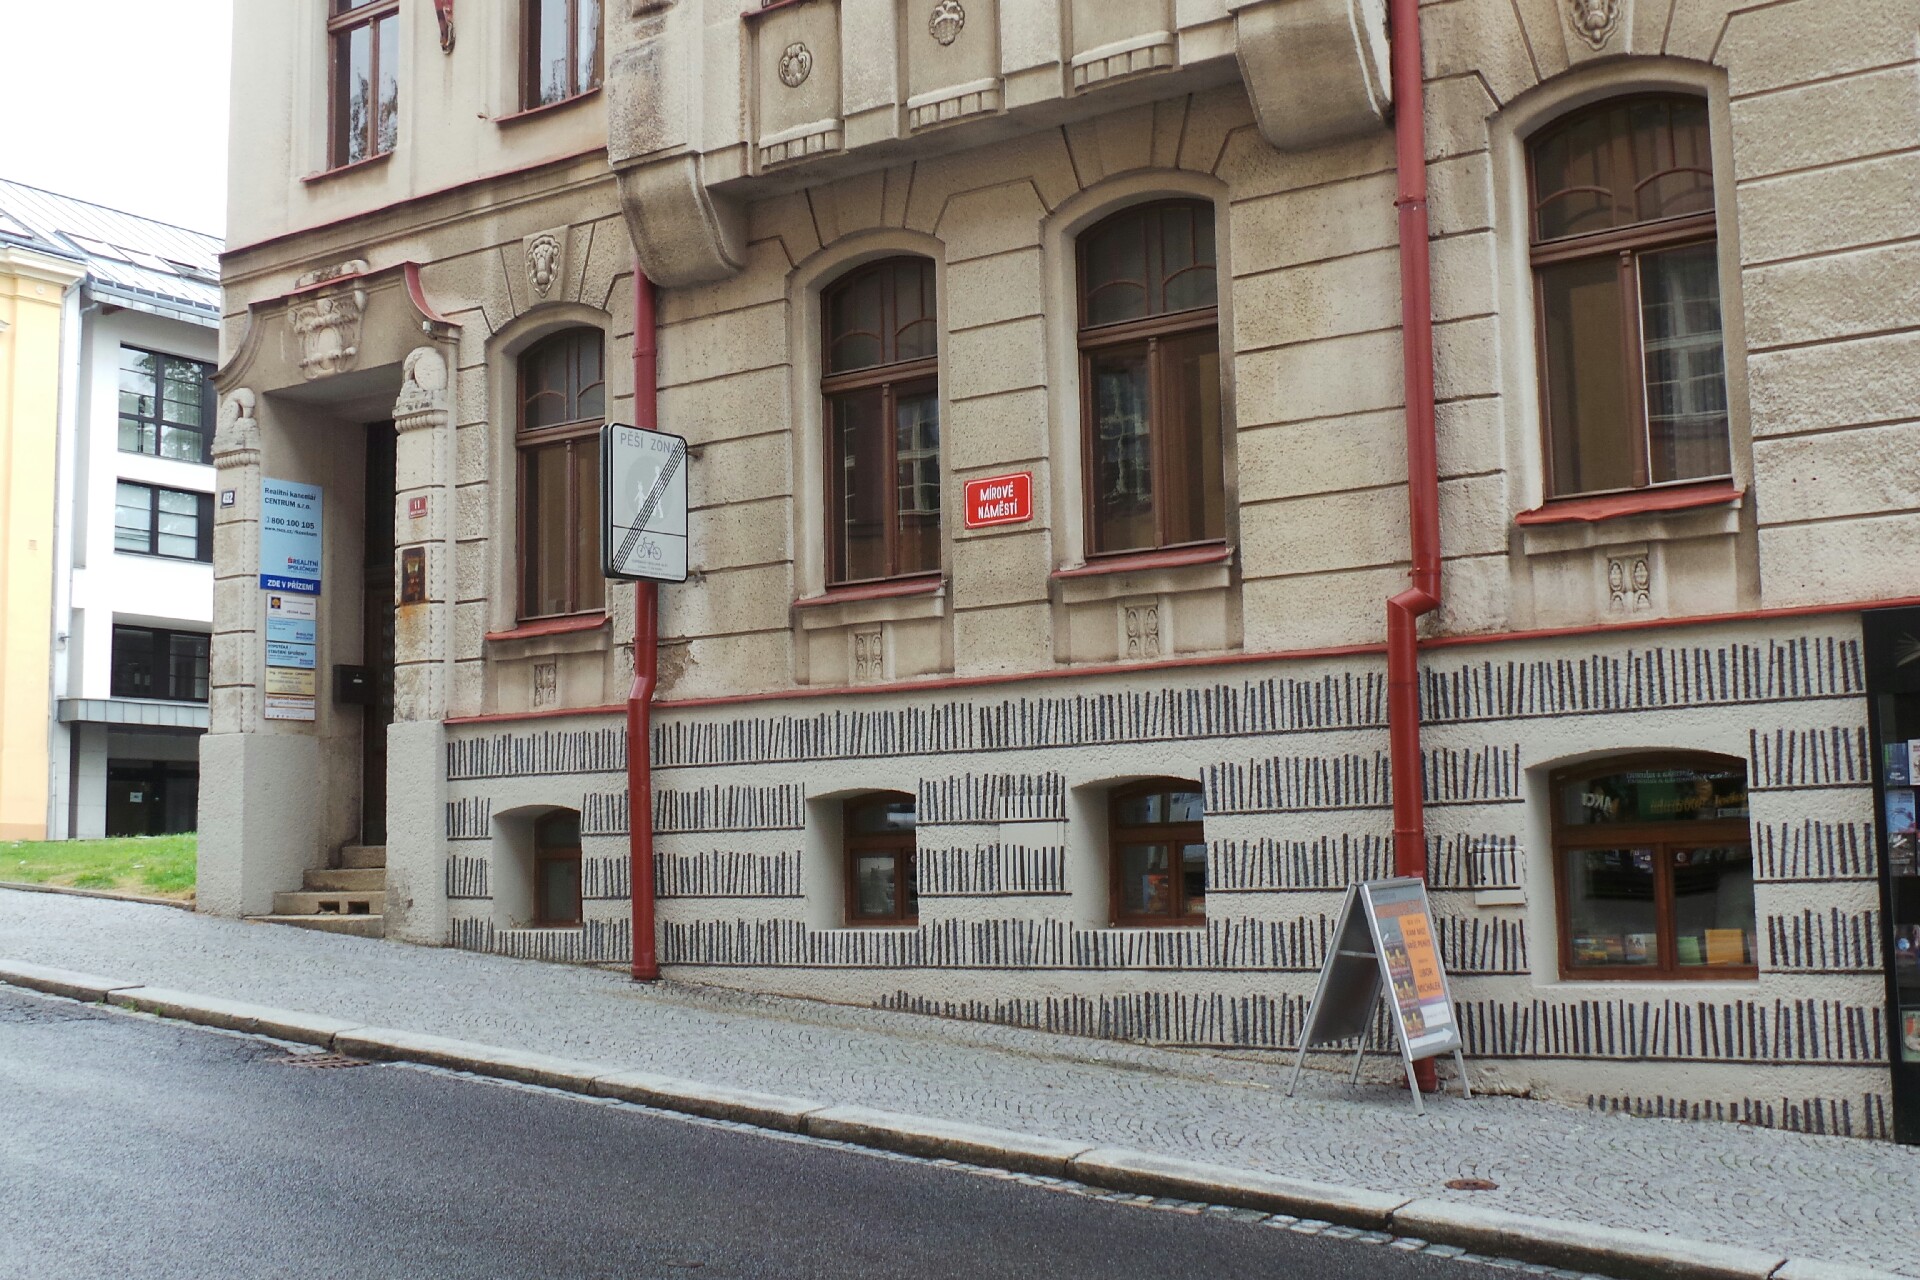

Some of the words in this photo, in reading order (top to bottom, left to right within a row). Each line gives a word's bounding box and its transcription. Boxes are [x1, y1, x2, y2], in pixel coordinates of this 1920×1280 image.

[620, 430, 644, 449] PĚŠÍ
[980, 481, 1014, 502] MÍROVÉ
[264, 497, 296, 508] CENTRUM
[978, 498, 1018, 519] NÁMĚSTÍ
[271, 517, 285, 526] 800
[286, 519, 300, 528] 100
[301, 521, 315, 530] 105
[267, 579, 281, 588] ZDE
[281, 580, 287, 589] V
[287, 580, 314, 592] PŘÍZEMÍ
